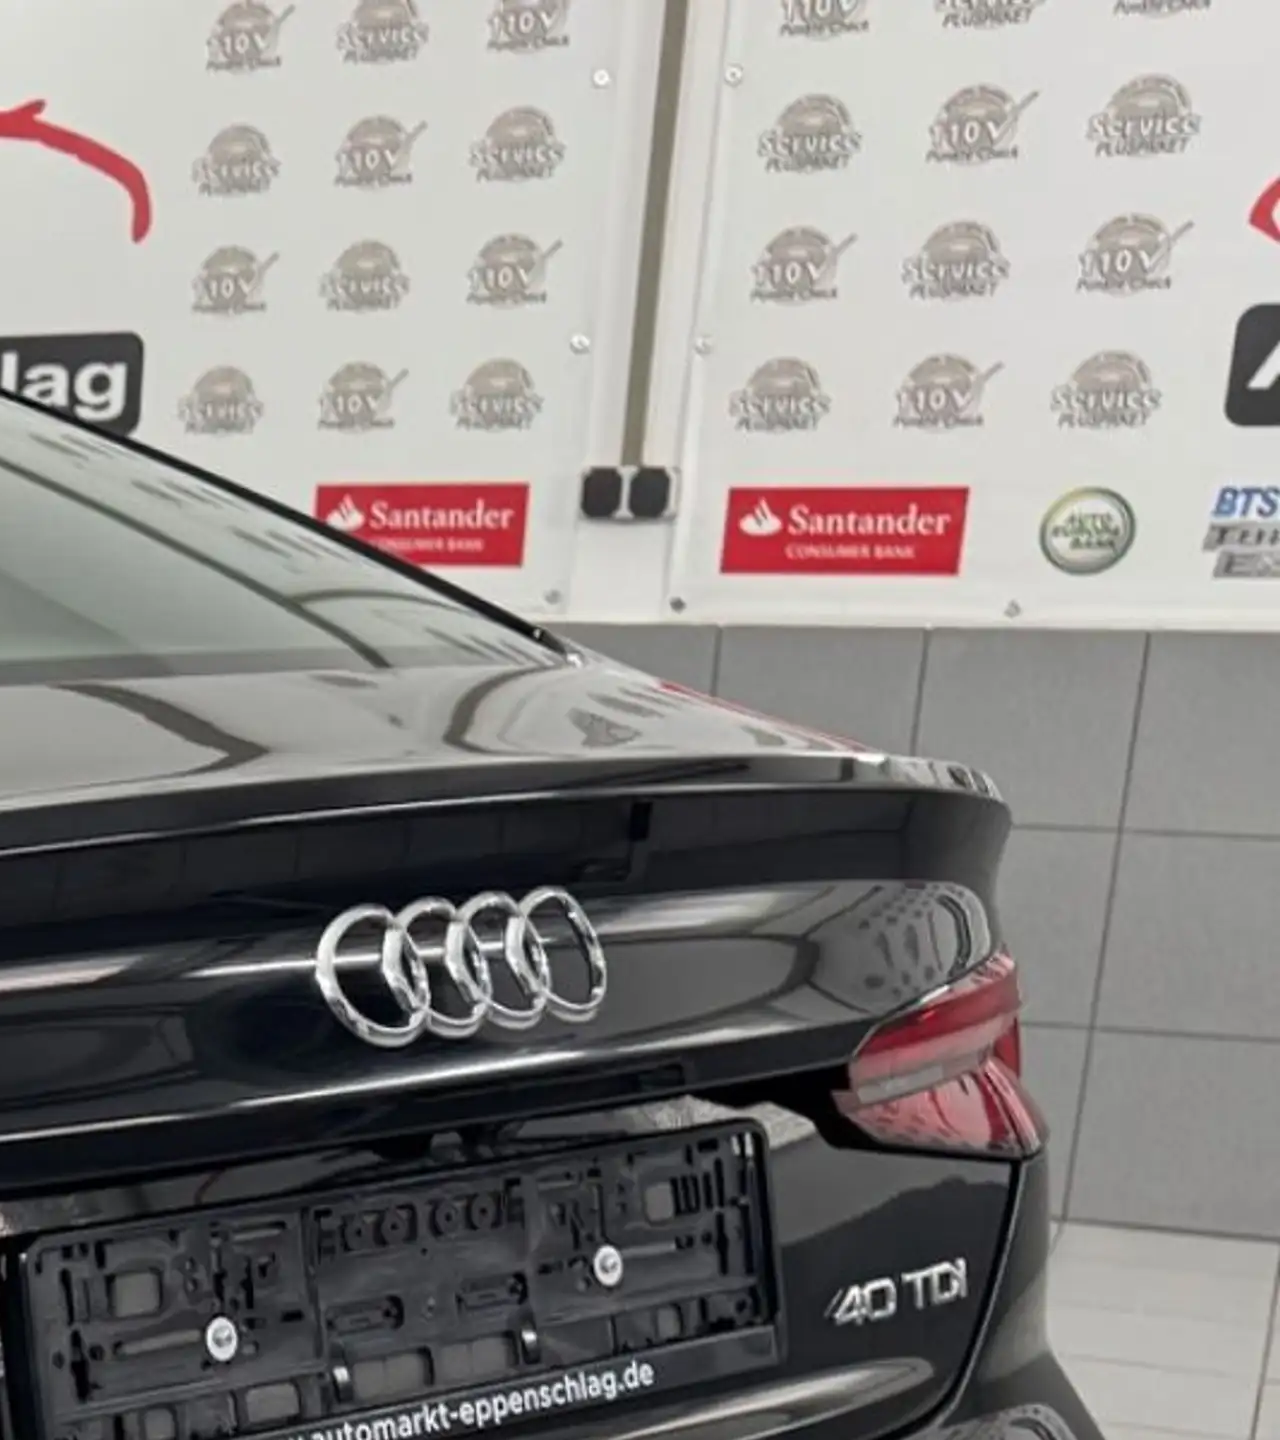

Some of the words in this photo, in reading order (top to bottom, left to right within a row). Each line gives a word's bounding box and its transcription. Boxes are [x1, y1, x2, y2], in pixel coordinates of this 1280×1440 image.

[370, 498, 514, 531] Santander
[1212, 486, 1280, 518] BTS
[788, 503, 951, 537] Santander
[785, 543, 870, 559] CONSUMER
[874, 543, 916, 559] BANK
[828, 1277, 897, 1326] 40
[901, 1257, 968, 1309] TDI
